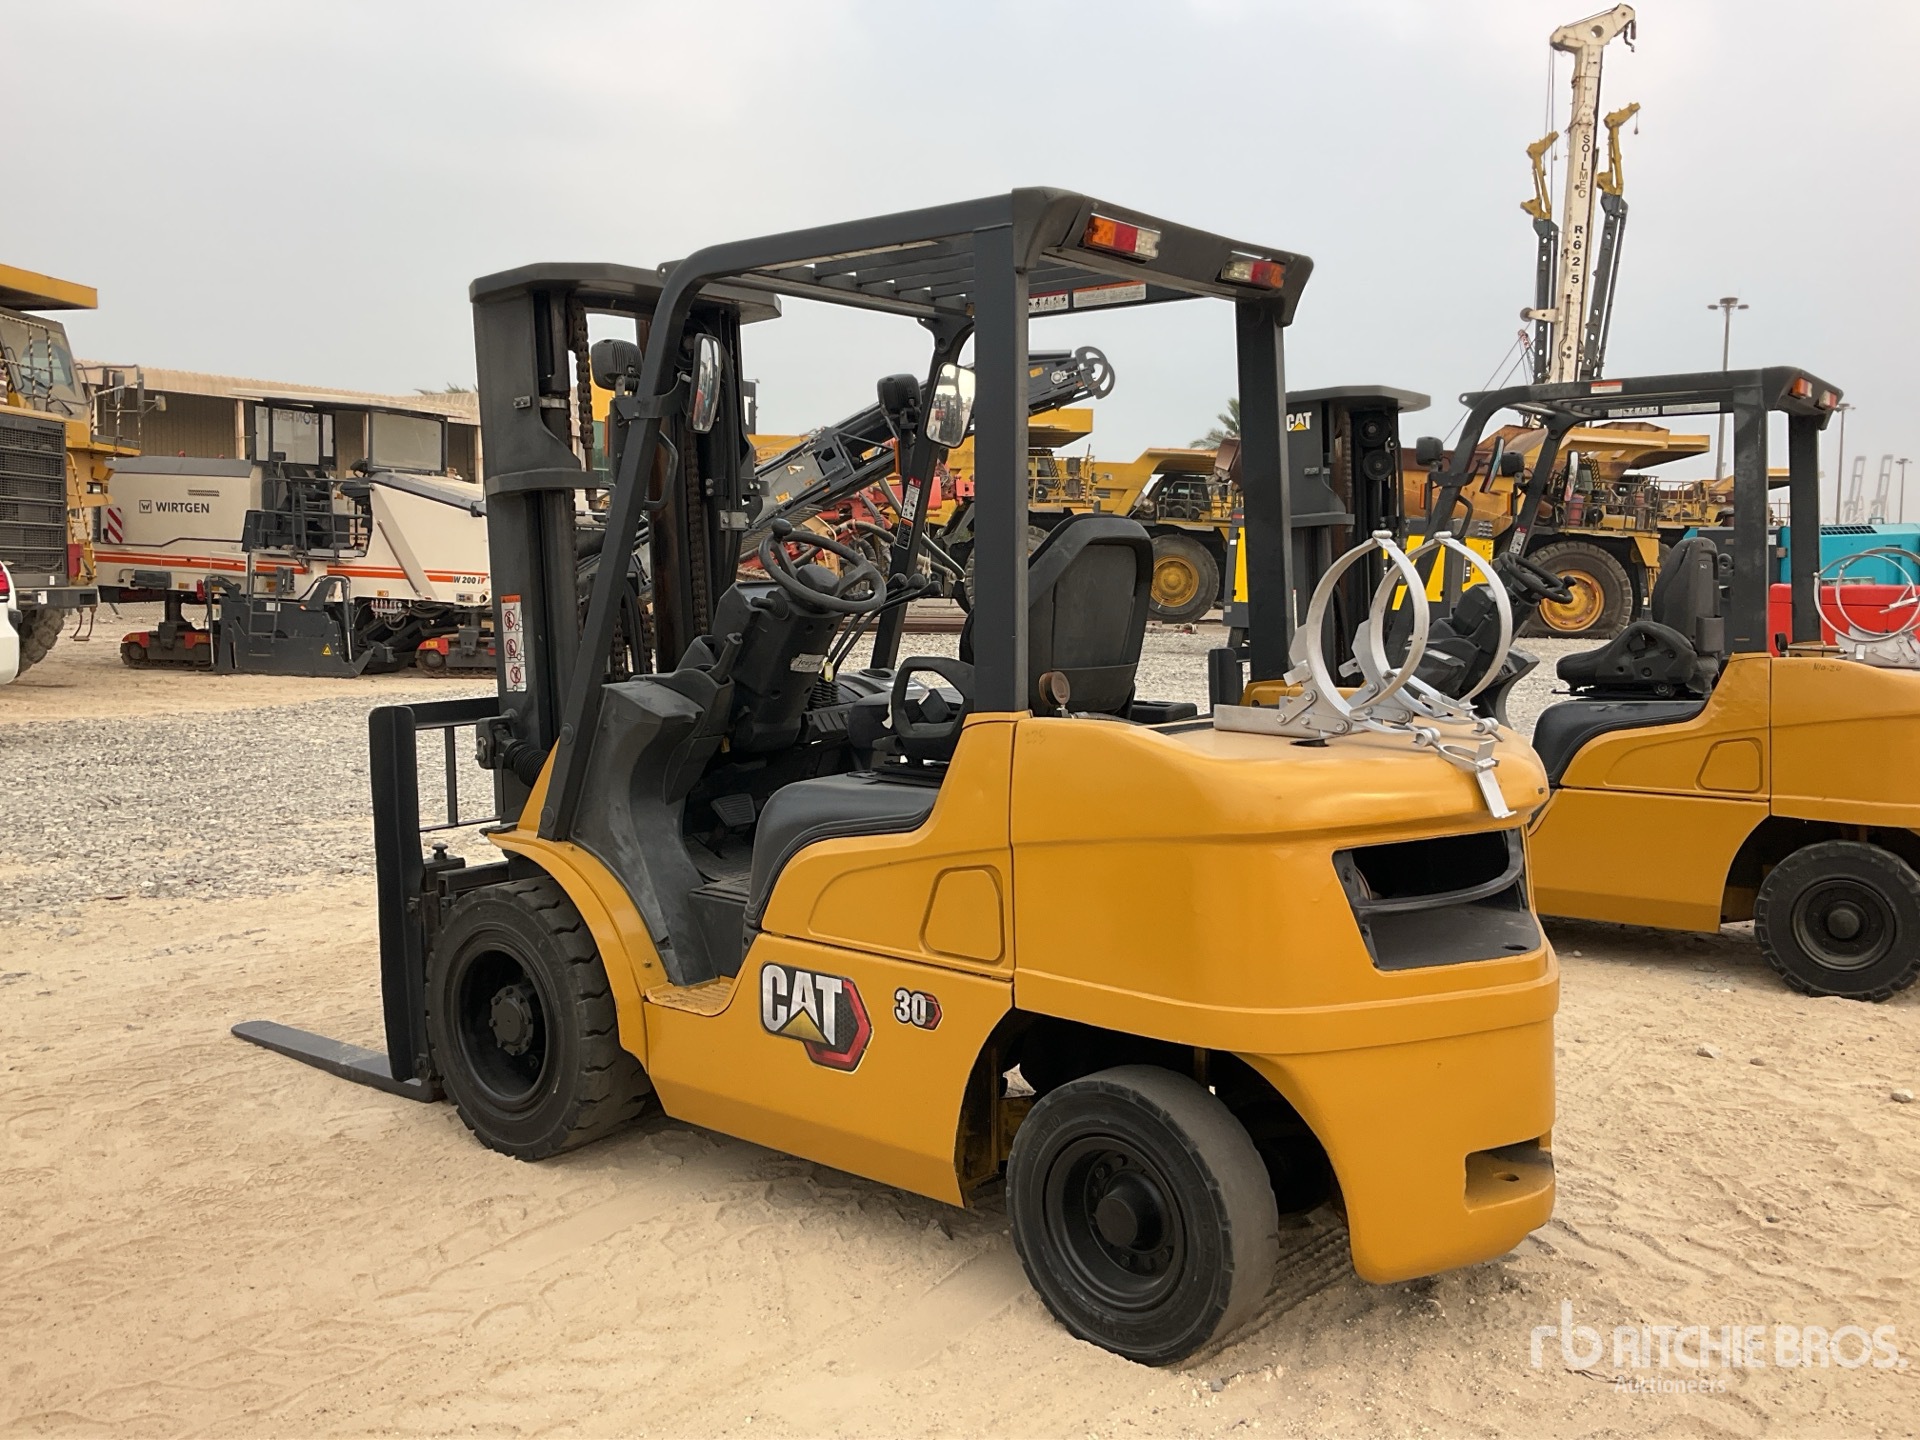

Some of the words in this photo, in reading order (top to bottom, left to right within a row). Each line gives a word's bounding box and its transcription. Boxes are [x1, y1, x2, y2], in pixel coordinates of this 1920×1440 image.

[1578, 134, 1591, 199] SOILMEC
[1286, 411, 1312, 432] CAT
[156, 502, 210, 513] WIRTGEN
[762, 964, 843, 1046] CAT
[895, 989, 927, 1026] 30
